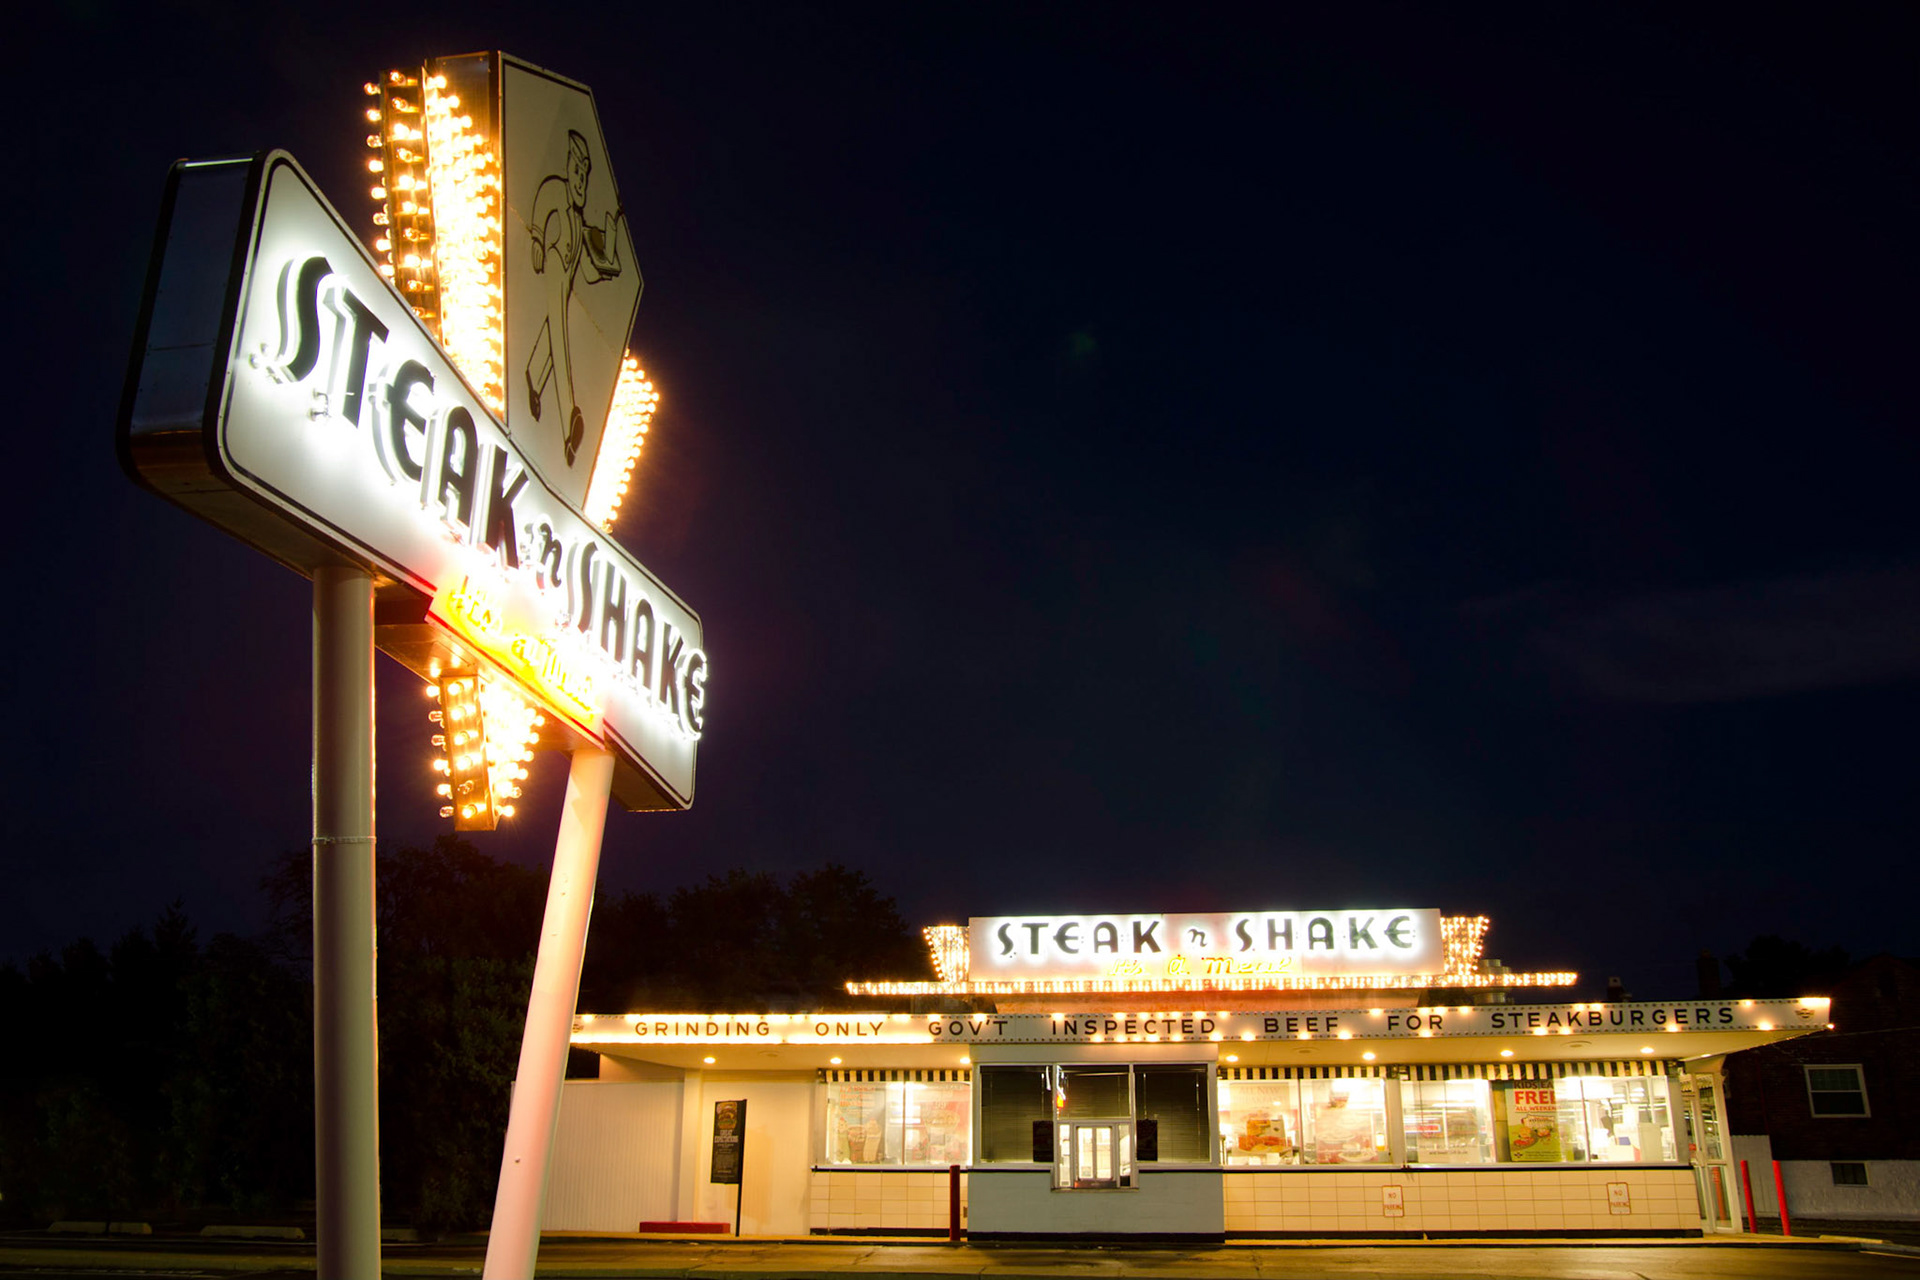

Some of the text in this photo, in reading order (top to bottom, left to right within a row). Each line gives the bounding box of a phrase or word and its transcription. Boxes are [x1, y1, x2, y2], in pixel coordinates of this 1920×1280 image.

[280, 254, 530, 570] STEAK
[576, 540, 707, 735] SHAKE
[998, 916, 1413, 956] STEAK n SHAKE
[635, 1006, 1734, 1036] GRINDING ONLY GOV'T INSPECTED BEEF FOR STEAKBURGERS
[1513, 1081, 1554, 1090] KIDS EA
